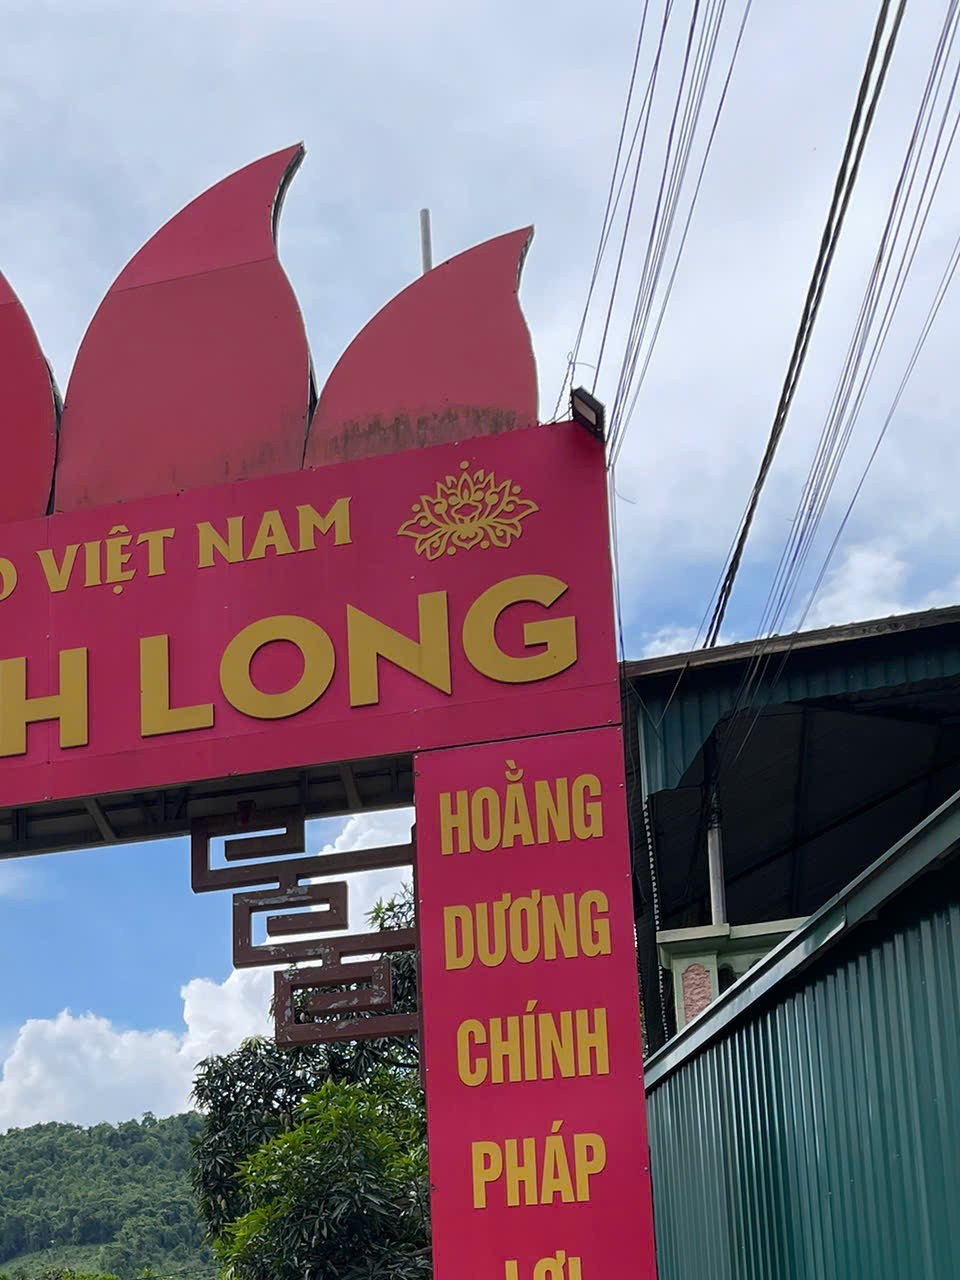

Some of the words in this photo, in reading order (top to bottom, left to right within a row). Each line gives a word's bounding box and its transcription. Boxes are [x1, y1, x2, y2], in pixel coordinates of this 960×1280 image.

[37, 525, 175, 594] VIỆT
[197, 497, 352, 568] NAM
[140, 574, 577, 737] LONG
[439, 760, 604, 855] HOẰNG
[443, 889, 611, 970] DƯƠNG
[456, 1000, 609, 1086] CHÍNH
[471, 1120, 607, 1209] PHÁP
